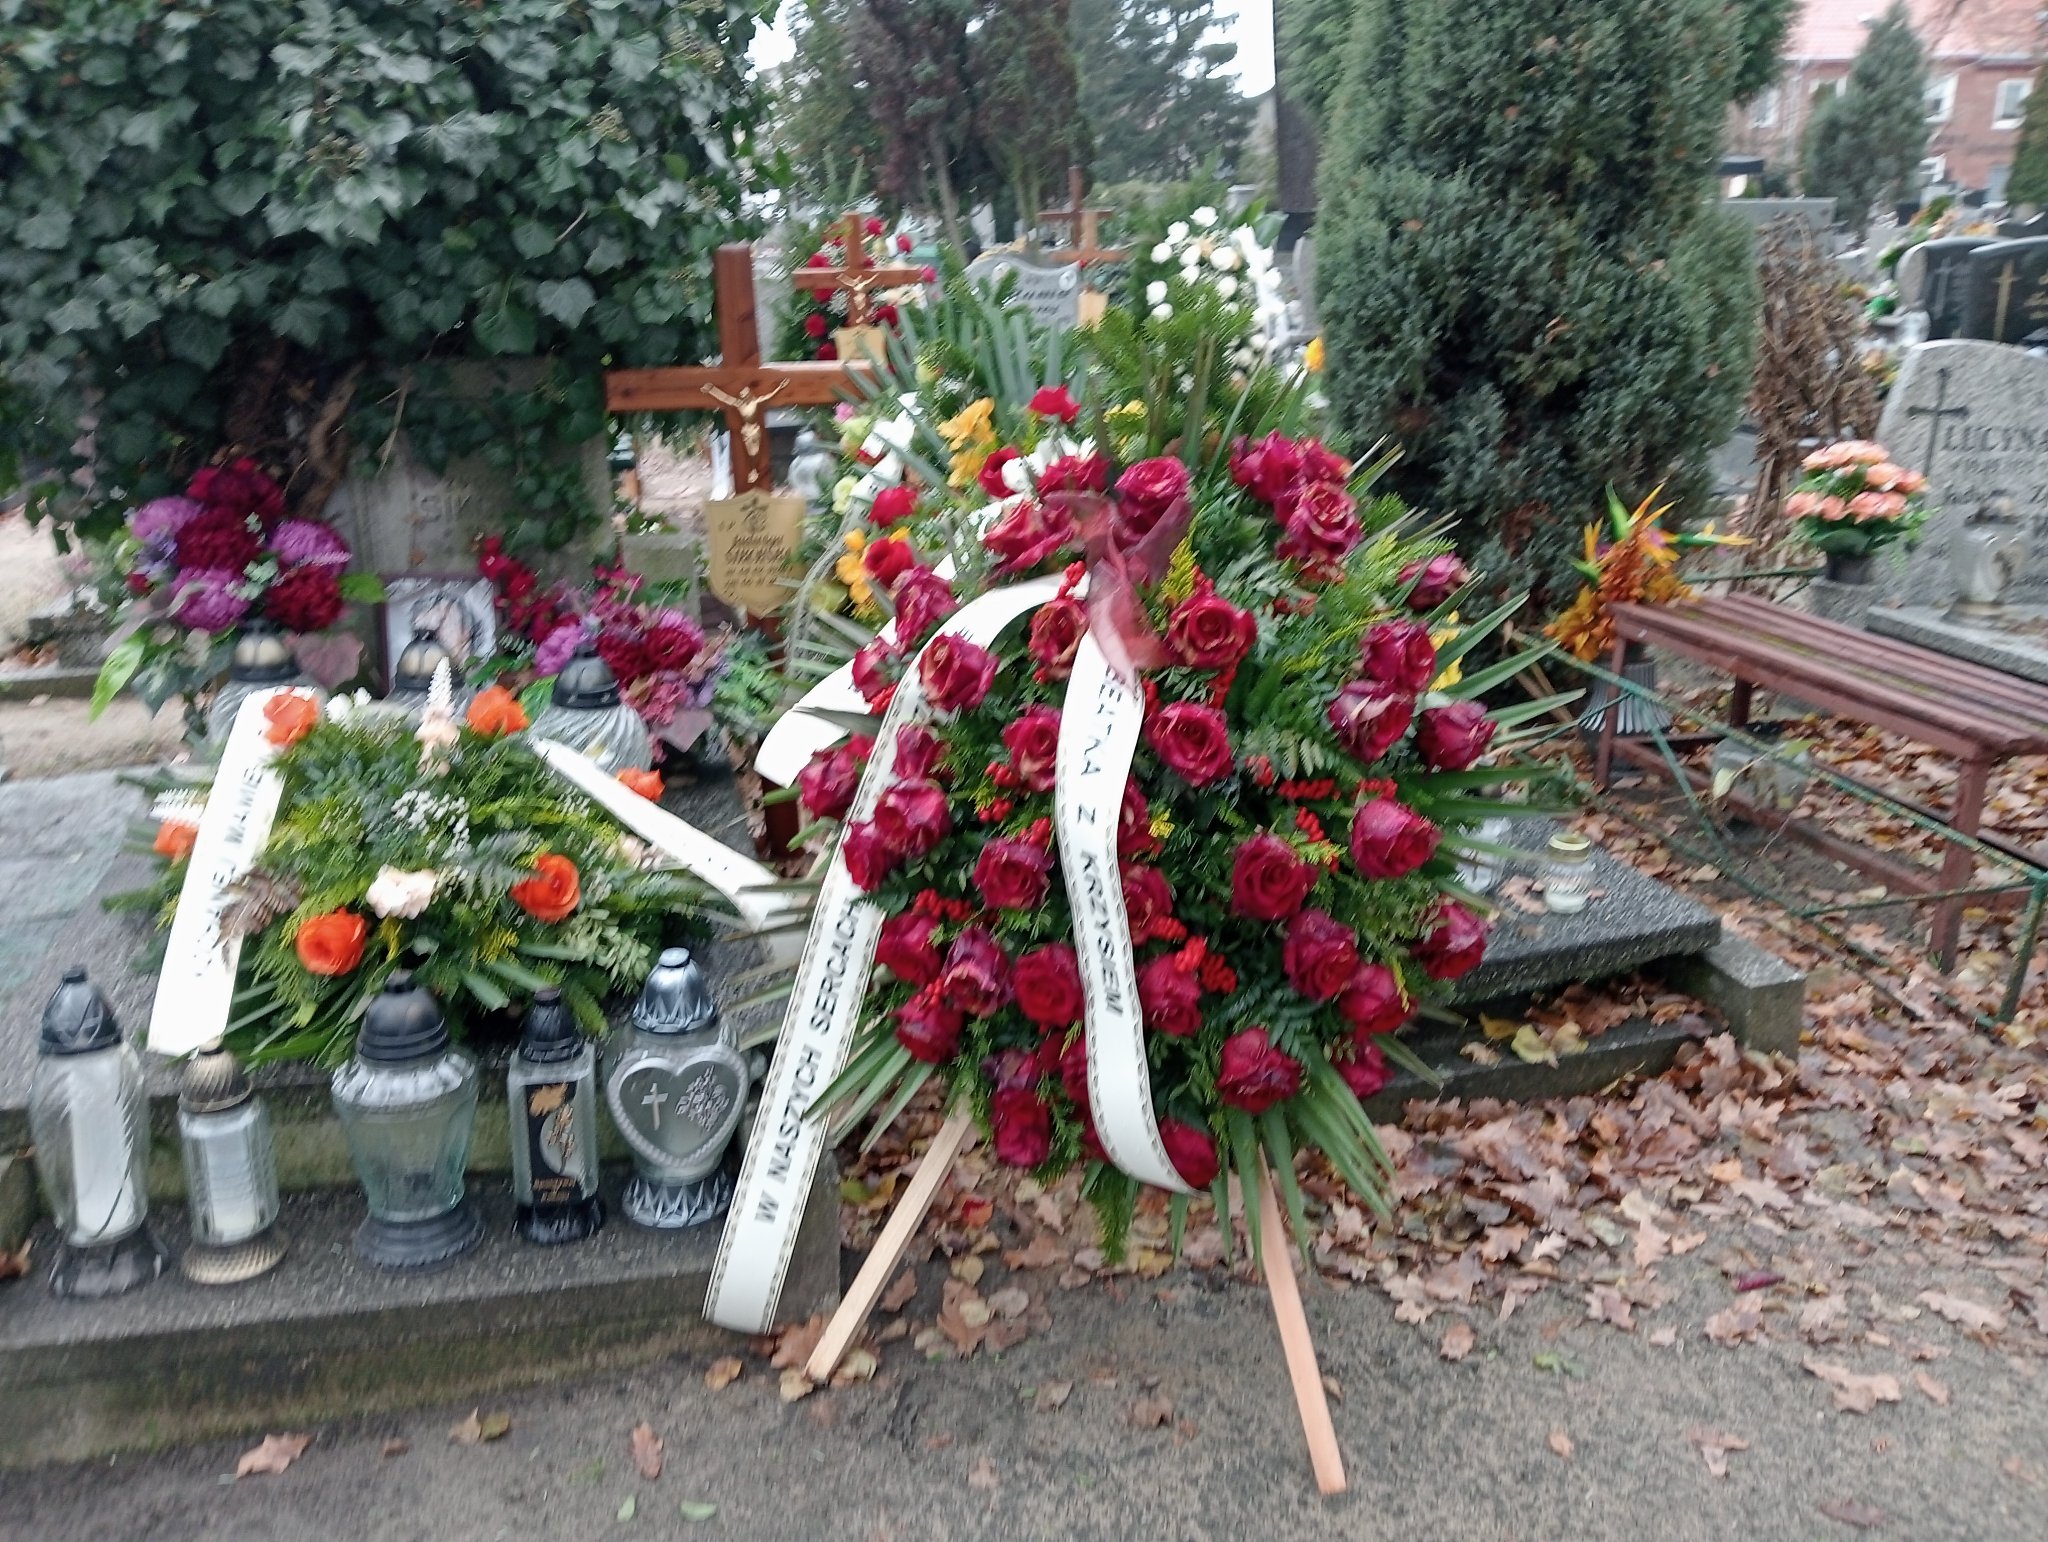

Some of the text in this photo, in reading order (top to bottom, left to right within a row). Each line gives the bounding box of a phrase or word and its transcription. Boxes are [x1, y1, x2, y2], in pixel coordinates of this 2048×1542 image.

[1080, 849, 1124, 1017] KRZYSIEM
[754, 898, 864, 1224] W NASZYCH SERCACH
